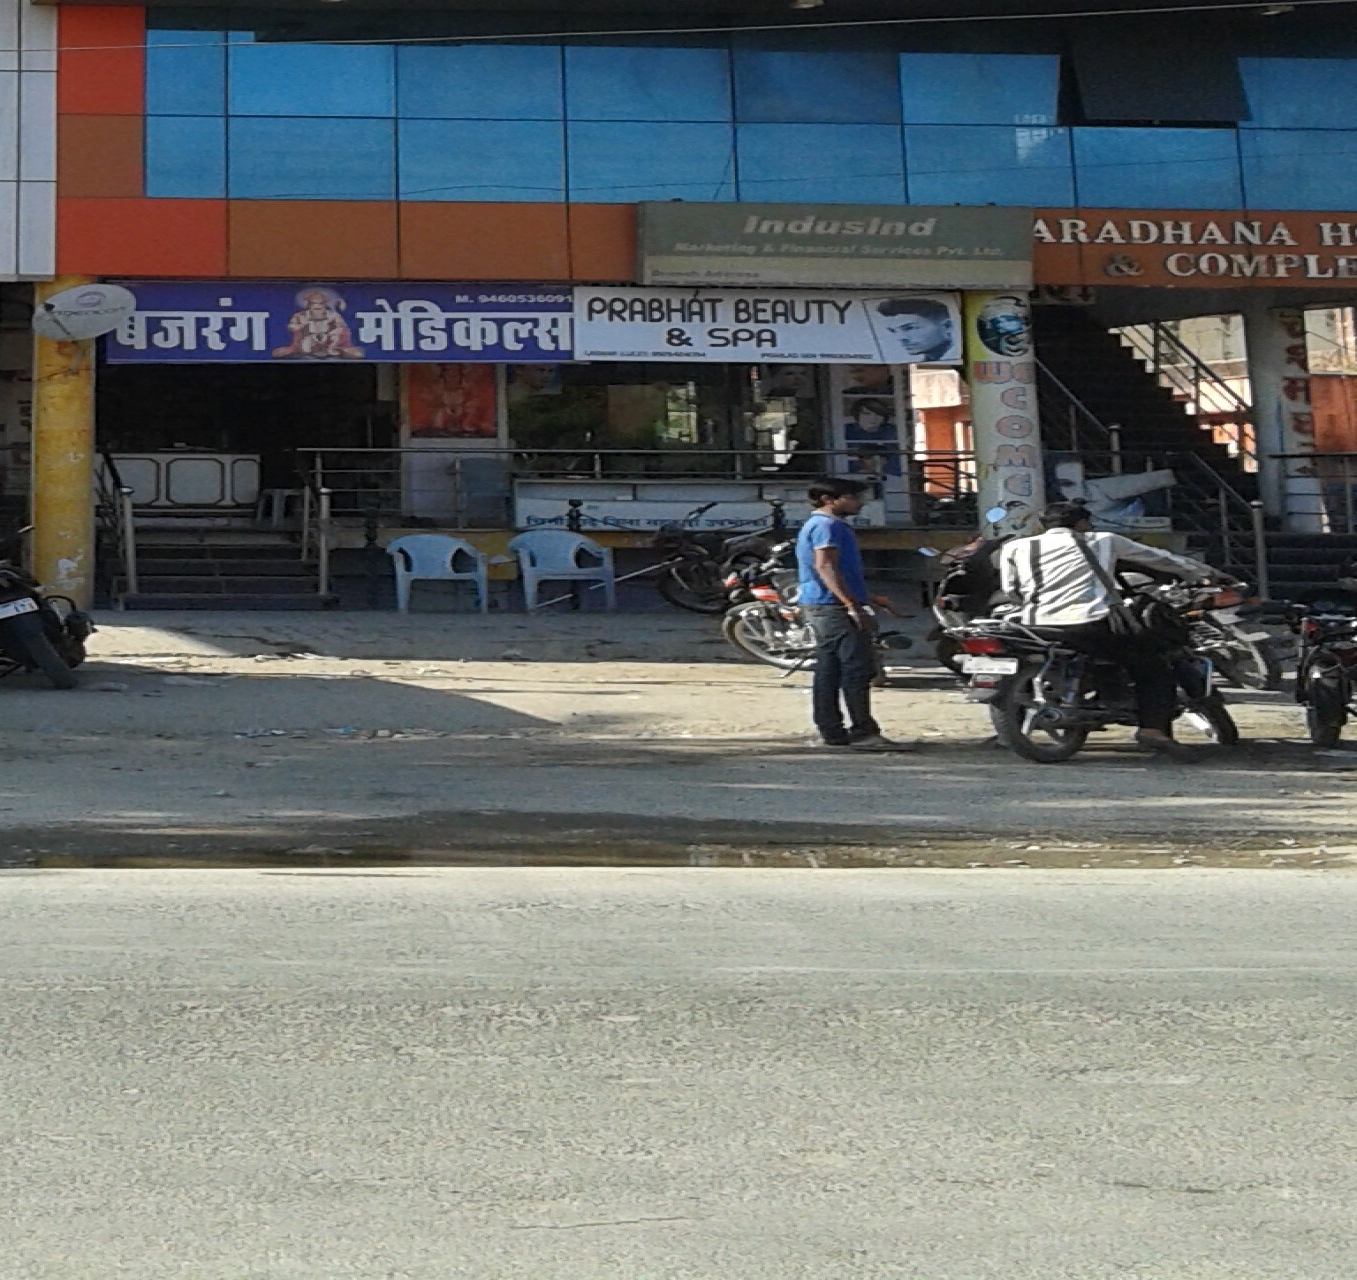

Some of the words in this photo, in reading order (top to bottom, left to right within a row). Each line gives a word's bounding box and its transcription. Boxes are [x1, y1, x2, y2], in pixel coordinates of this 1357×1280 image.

[1033, 218, 1298, 246] ARADHANA
[1106, 253, 1143, 277] &
[115, 297, 269, 352] बजरंग
[587, 297, 724, 324] PRABHAT
[733, 299, 852, 325] BEAUTY
[665, 328, 693, 347] &
[708, 328, 777, 348] SPA
